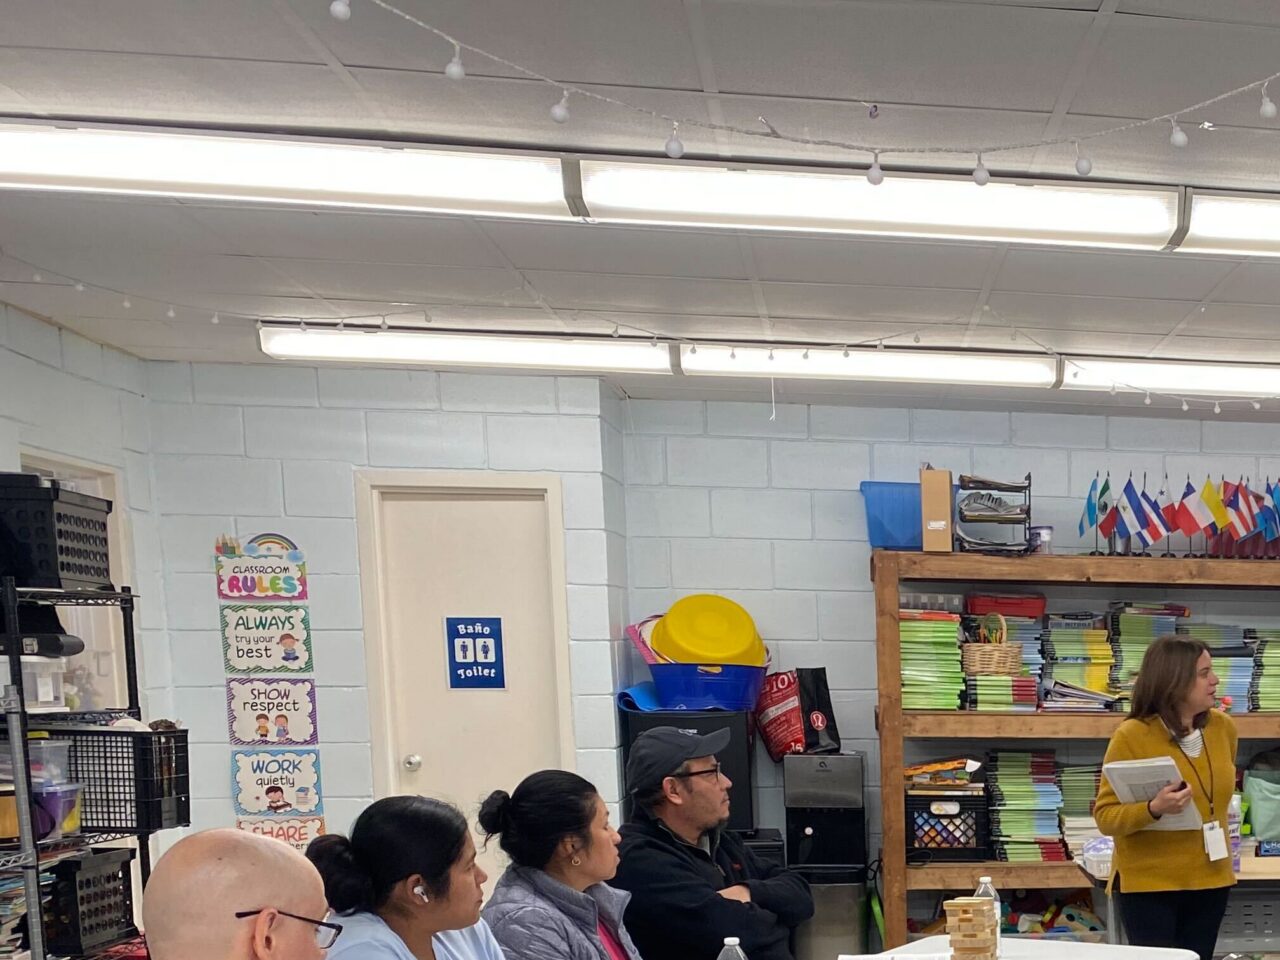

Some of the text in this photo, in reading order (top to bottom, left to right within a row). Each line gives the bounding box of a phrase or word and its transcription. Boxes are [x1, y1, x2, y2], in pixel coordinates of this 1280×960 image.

[232, 565, 290, 575] CLASSROOM
[228, 575, 299, 595] RULES
[234, 615, 295, 631] ALWAYS
[457, 622, 490, 634] Baño
[235, 635, 275, 646] try your
[236, 645, 273, 659] best
[457, 666, 496, 679] Toilet
[250, 688, 290, 701] SHOW
[243, 700, 300, 714] respect
[251, 758, 302, 775] WORK
[256, 775, 296, 788] quietly
[252, 825, 309, 841] SHARE
